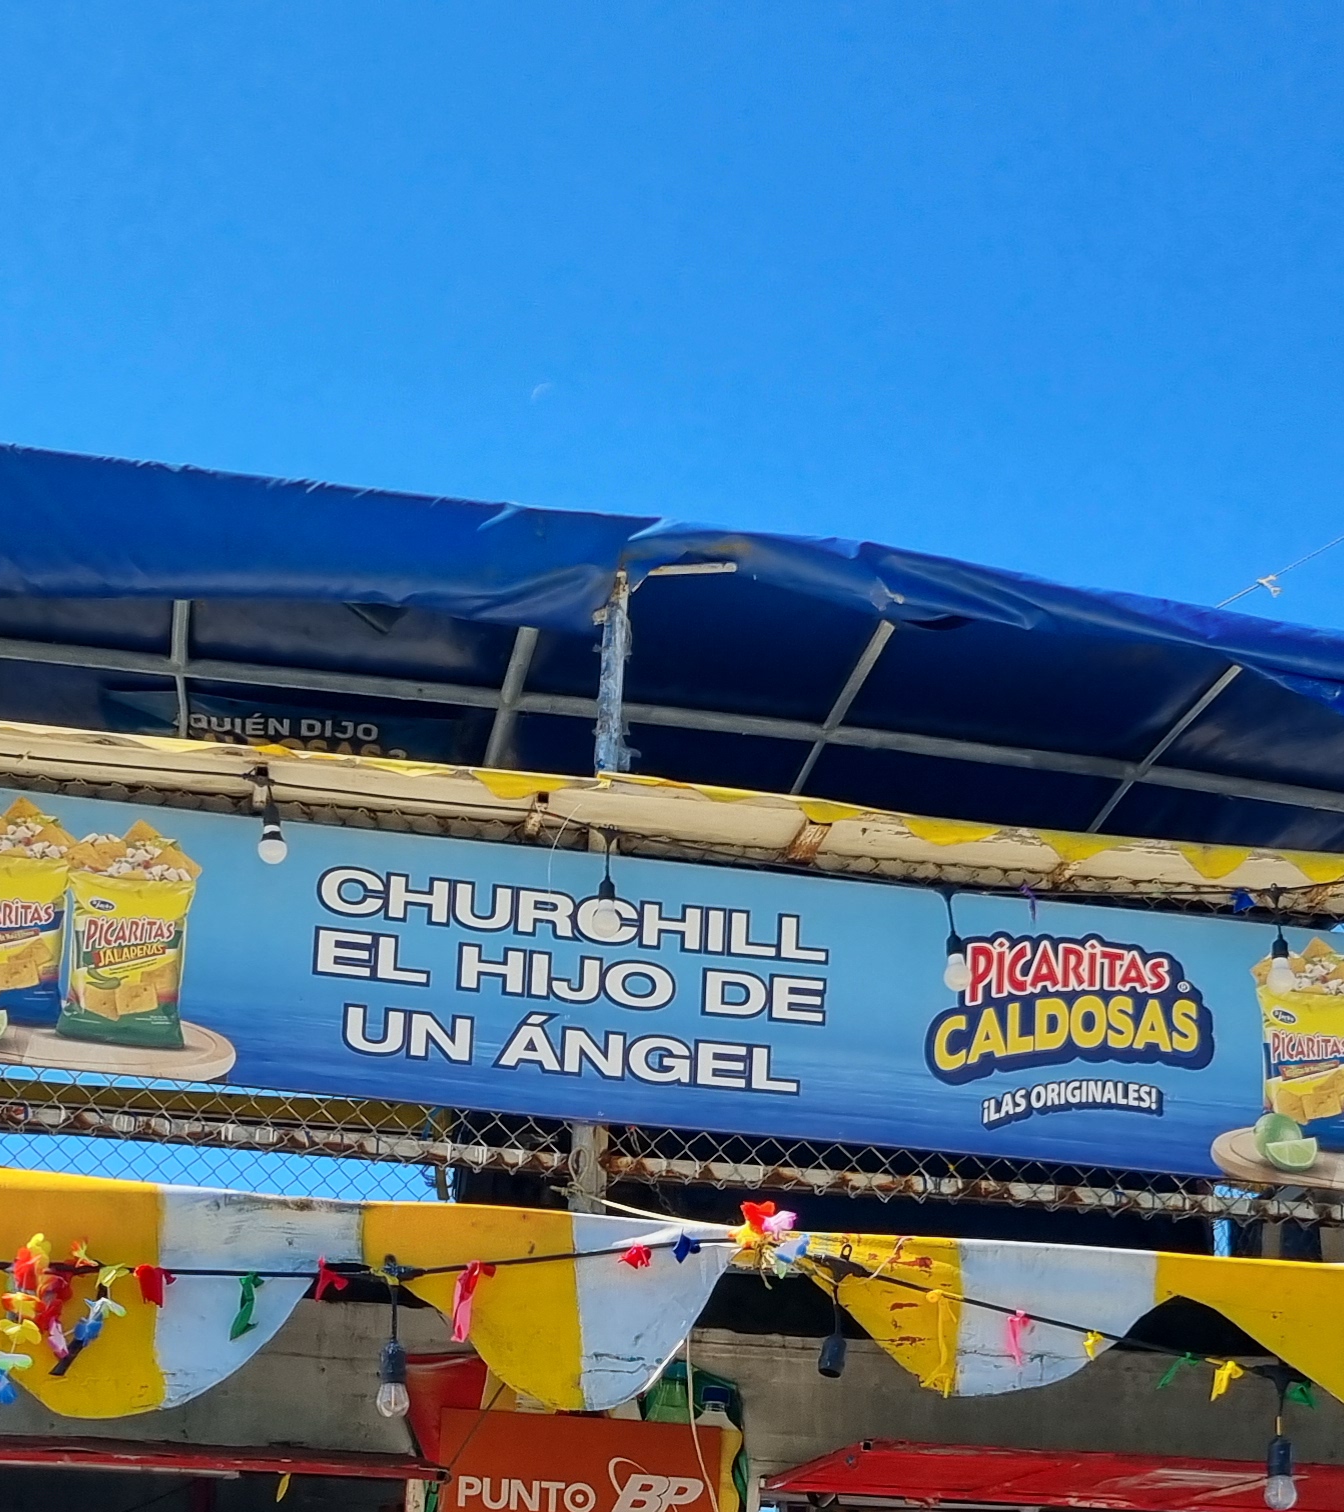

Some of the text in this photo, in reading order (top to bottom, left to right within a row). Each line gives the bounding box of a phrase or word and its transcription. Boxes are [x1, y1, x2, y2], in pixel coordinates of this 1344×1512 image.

[300, 719, 379, 742] DIJO
[317, 866, 829, 963] CHURCHILL
[313, 926, 826, 1025] EL HIJO DE
[342, 1003, 801, 1095] UN ÁNGEL
[934, 995, 1199, 1071] CALDOSAS
[982, 1080, 1157, 1124] ¡LAS ORIGINALES!
